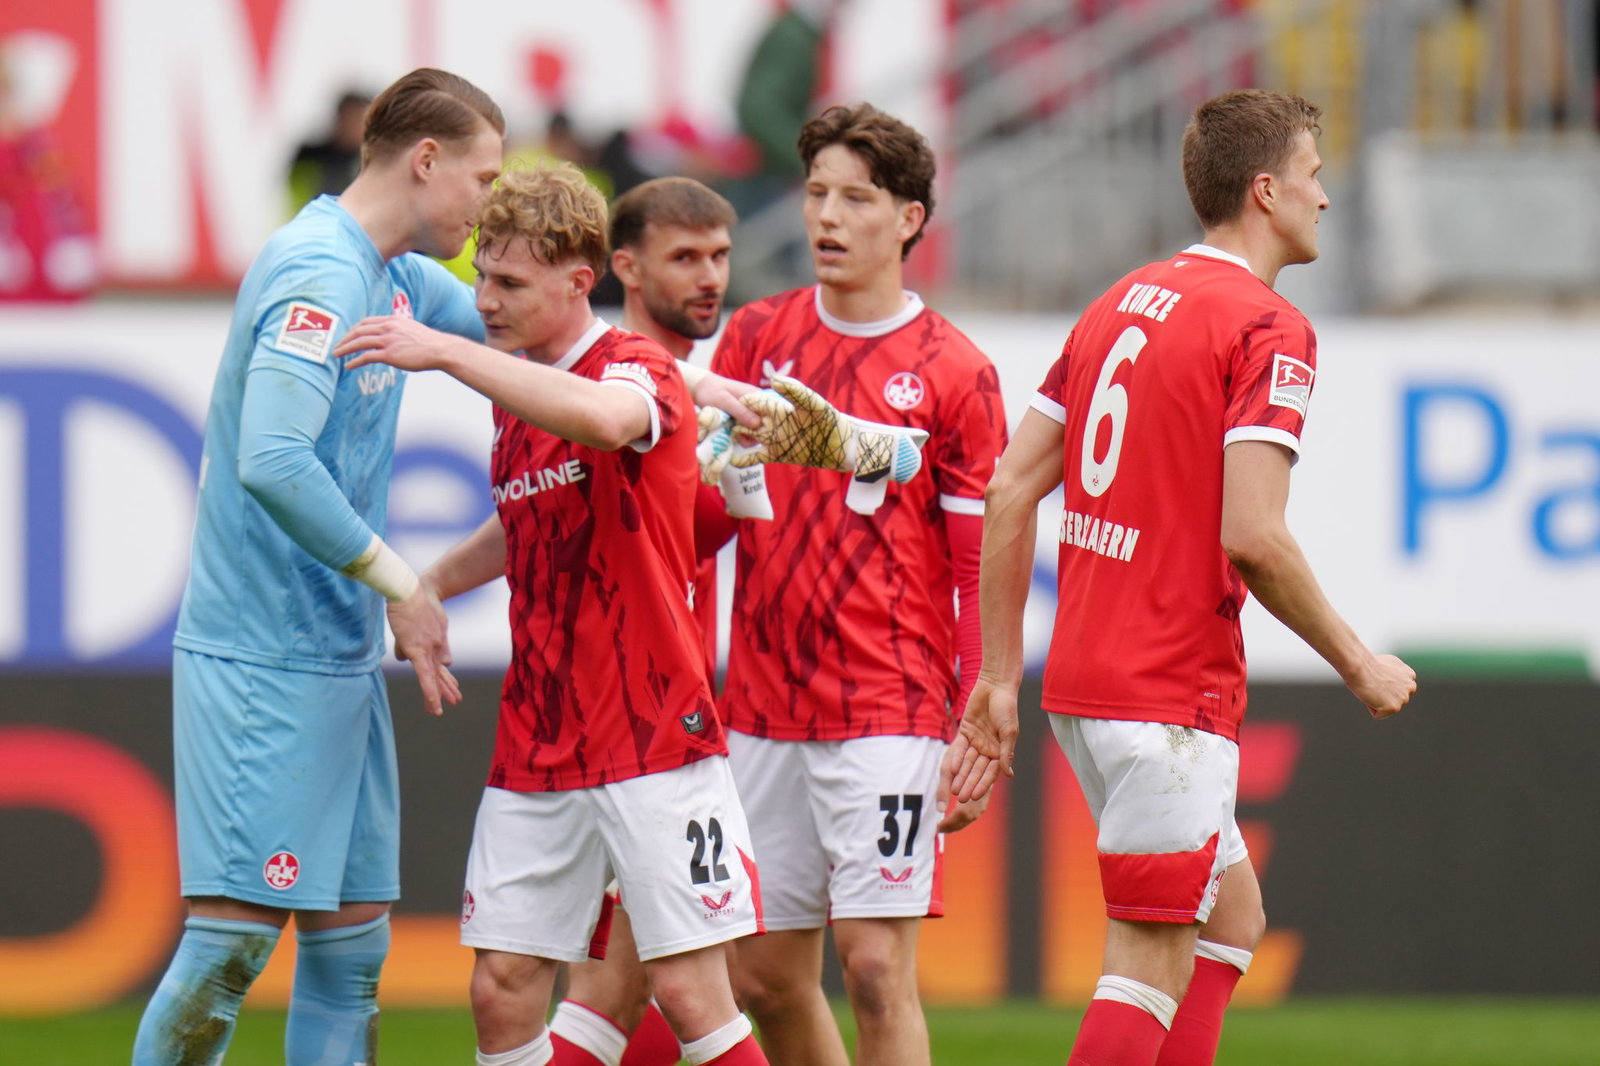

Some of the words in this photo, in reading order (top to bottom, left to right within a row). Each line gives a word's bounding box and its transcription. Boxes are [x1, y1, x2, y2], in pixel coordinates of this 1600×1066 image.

[1117, 283, 1182, 323] KUNZE
[1081, 326, 1148, 498] 6
[1401, 382, 1600, 560] Pa
[686, 816, 731, 885] 22
[877, 794, 923, 857] 37
